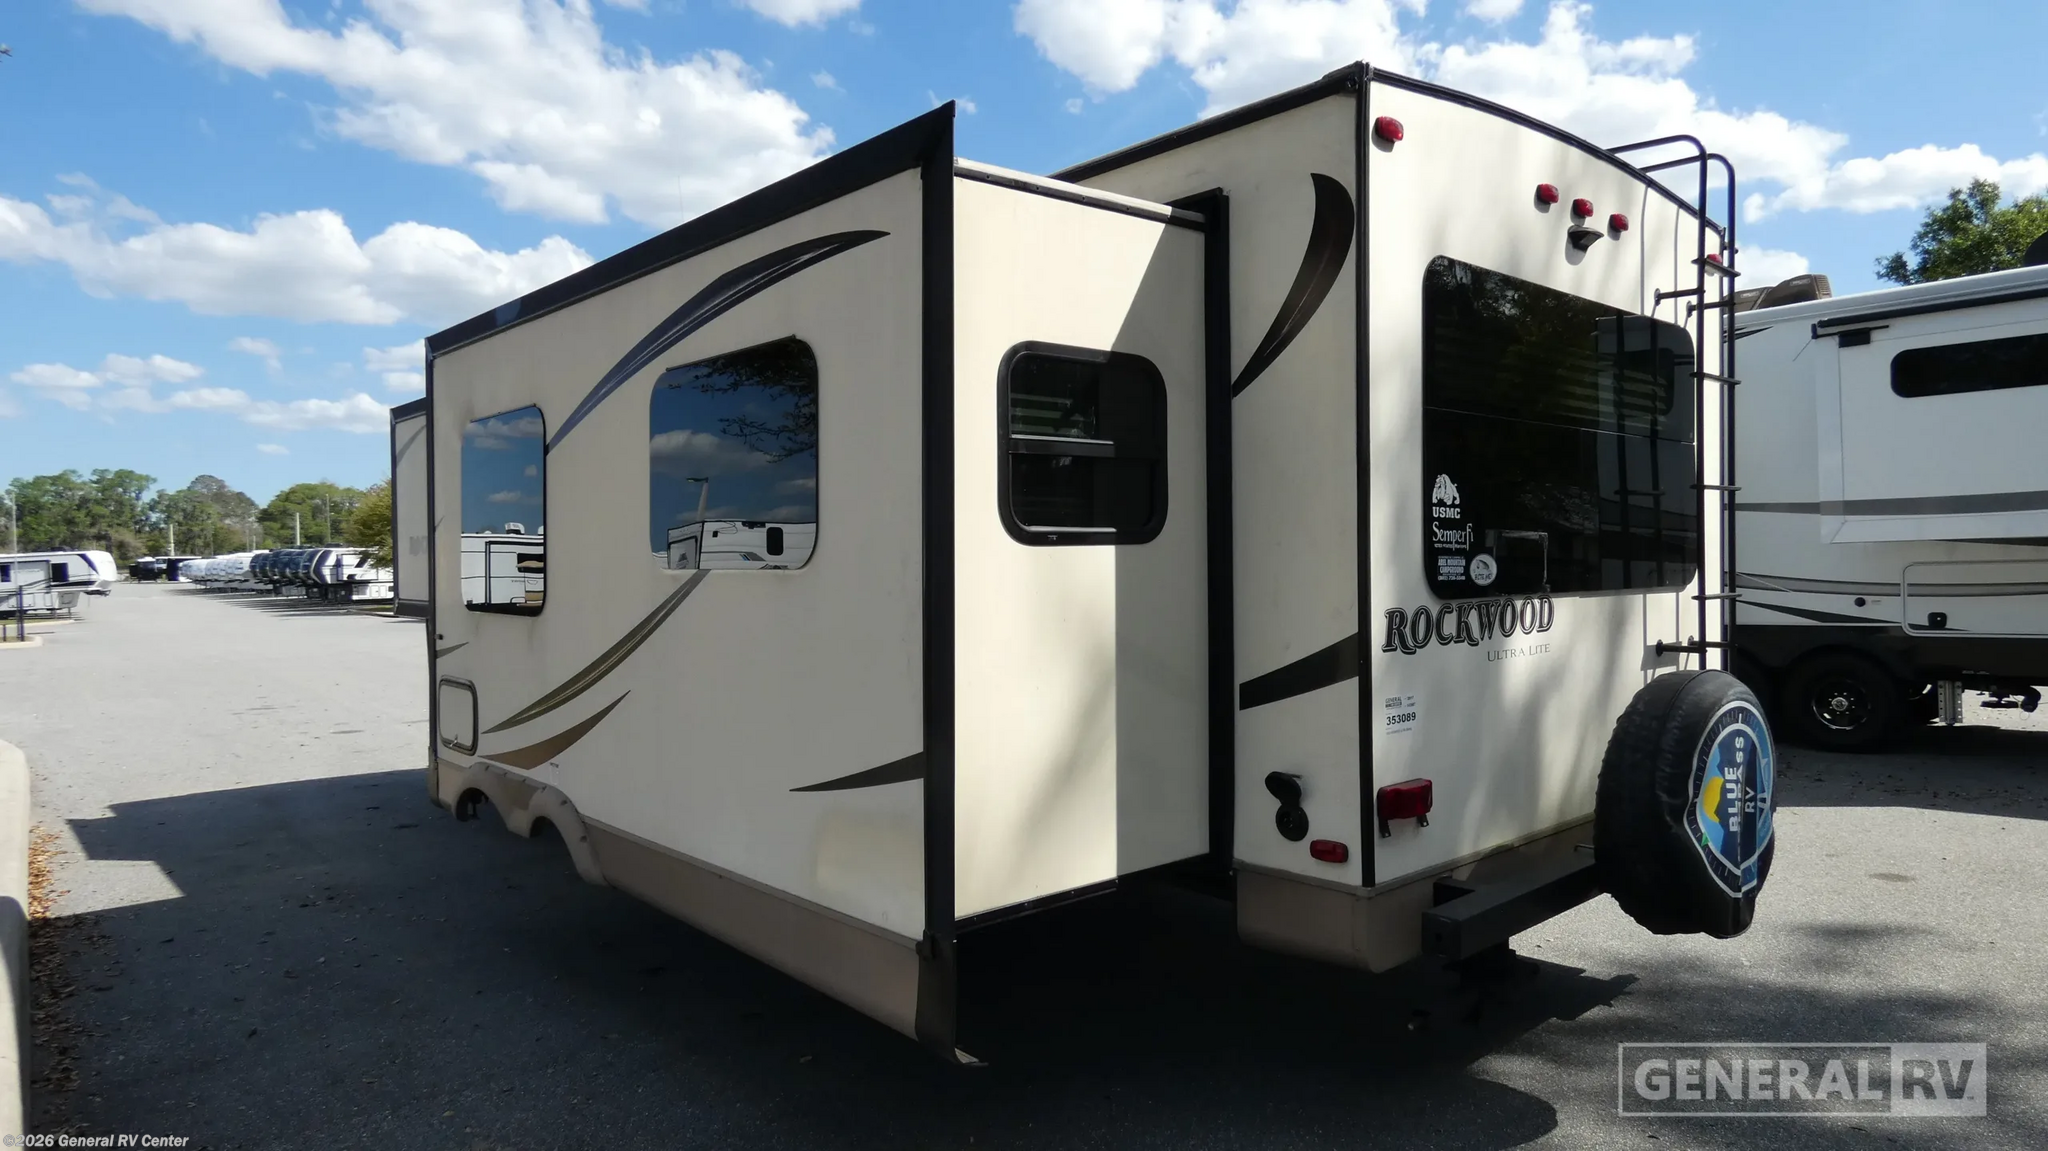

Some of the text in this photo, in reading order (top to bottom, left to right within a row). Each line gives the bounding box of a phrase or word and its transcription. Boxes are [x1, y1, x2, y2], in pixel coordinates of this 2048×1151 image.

[1432, 506, 1461, 519] USMC
[1382, 595, 1555, 655] ROCKWOOD
[1487, 643, 1551, 662] ULTRA LITE
[1386, 711, 1417, 726] 353089
[1724, 767, 1739, 832] BLUE
[1744, 786, 1755, 813] RV
